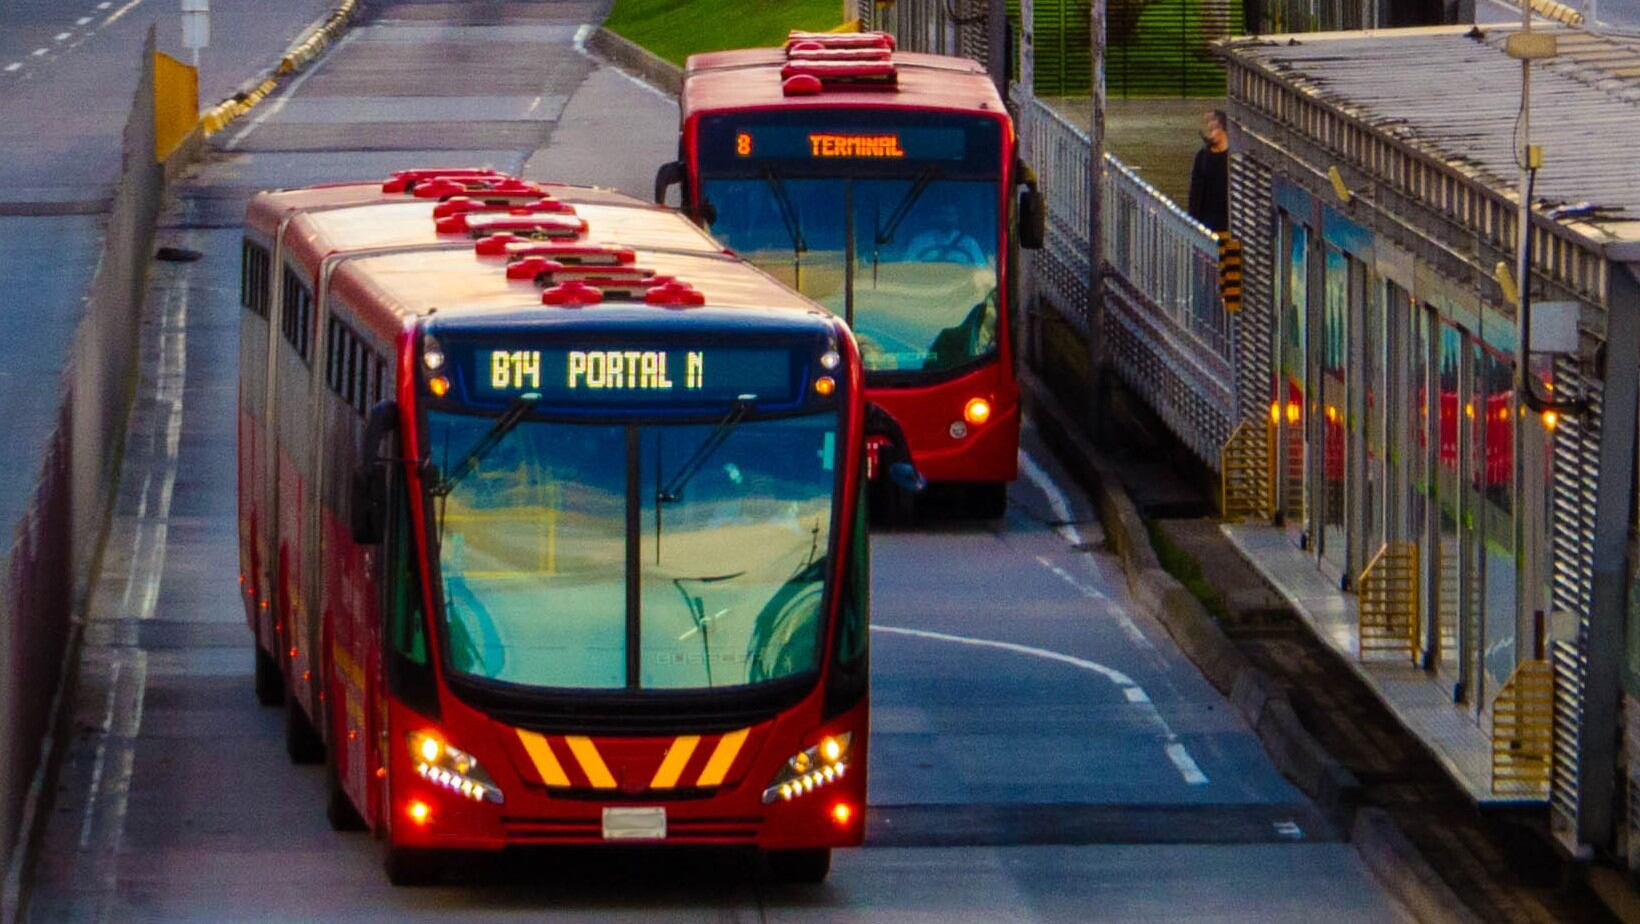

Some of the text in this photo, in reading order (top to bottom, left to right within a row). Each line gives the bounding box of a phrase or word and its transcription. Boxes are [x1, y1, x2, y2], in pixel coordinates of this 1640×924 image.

[737, 133, 904, 157] 8 TERMINAL
[491, 350, 704, 389] B14 PORTAL N
